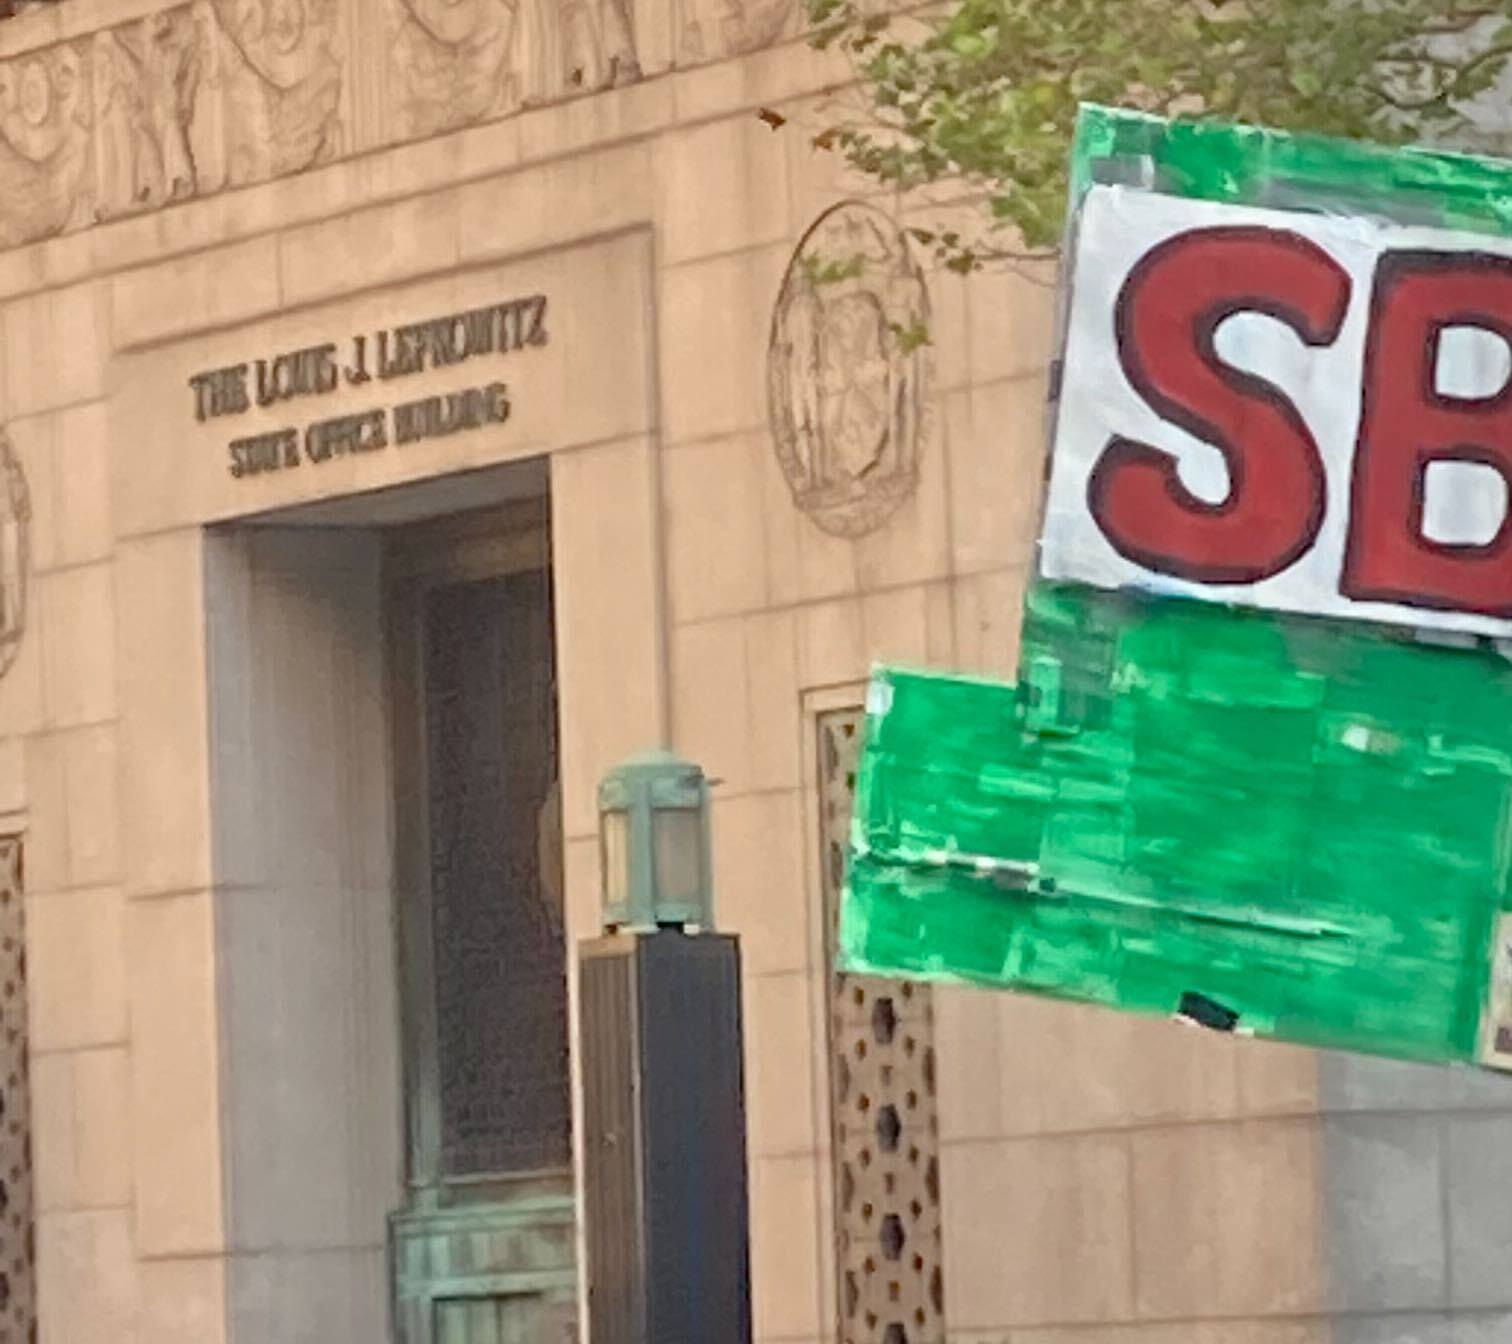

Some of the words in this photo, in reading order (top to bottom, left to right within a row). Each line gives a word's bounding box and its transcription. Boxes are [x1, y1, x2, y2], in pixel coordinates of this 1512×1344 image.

[189, 362, 251, 423] THE
[255, 342, 338, 407] LOUIS
[376, 294, 548, 381] LEFKOWITZ
[228, 426, 301, 479] STATE
[305, 408, 388, 464] OFFICE
[393, 380, 511, 446] BUILDING
